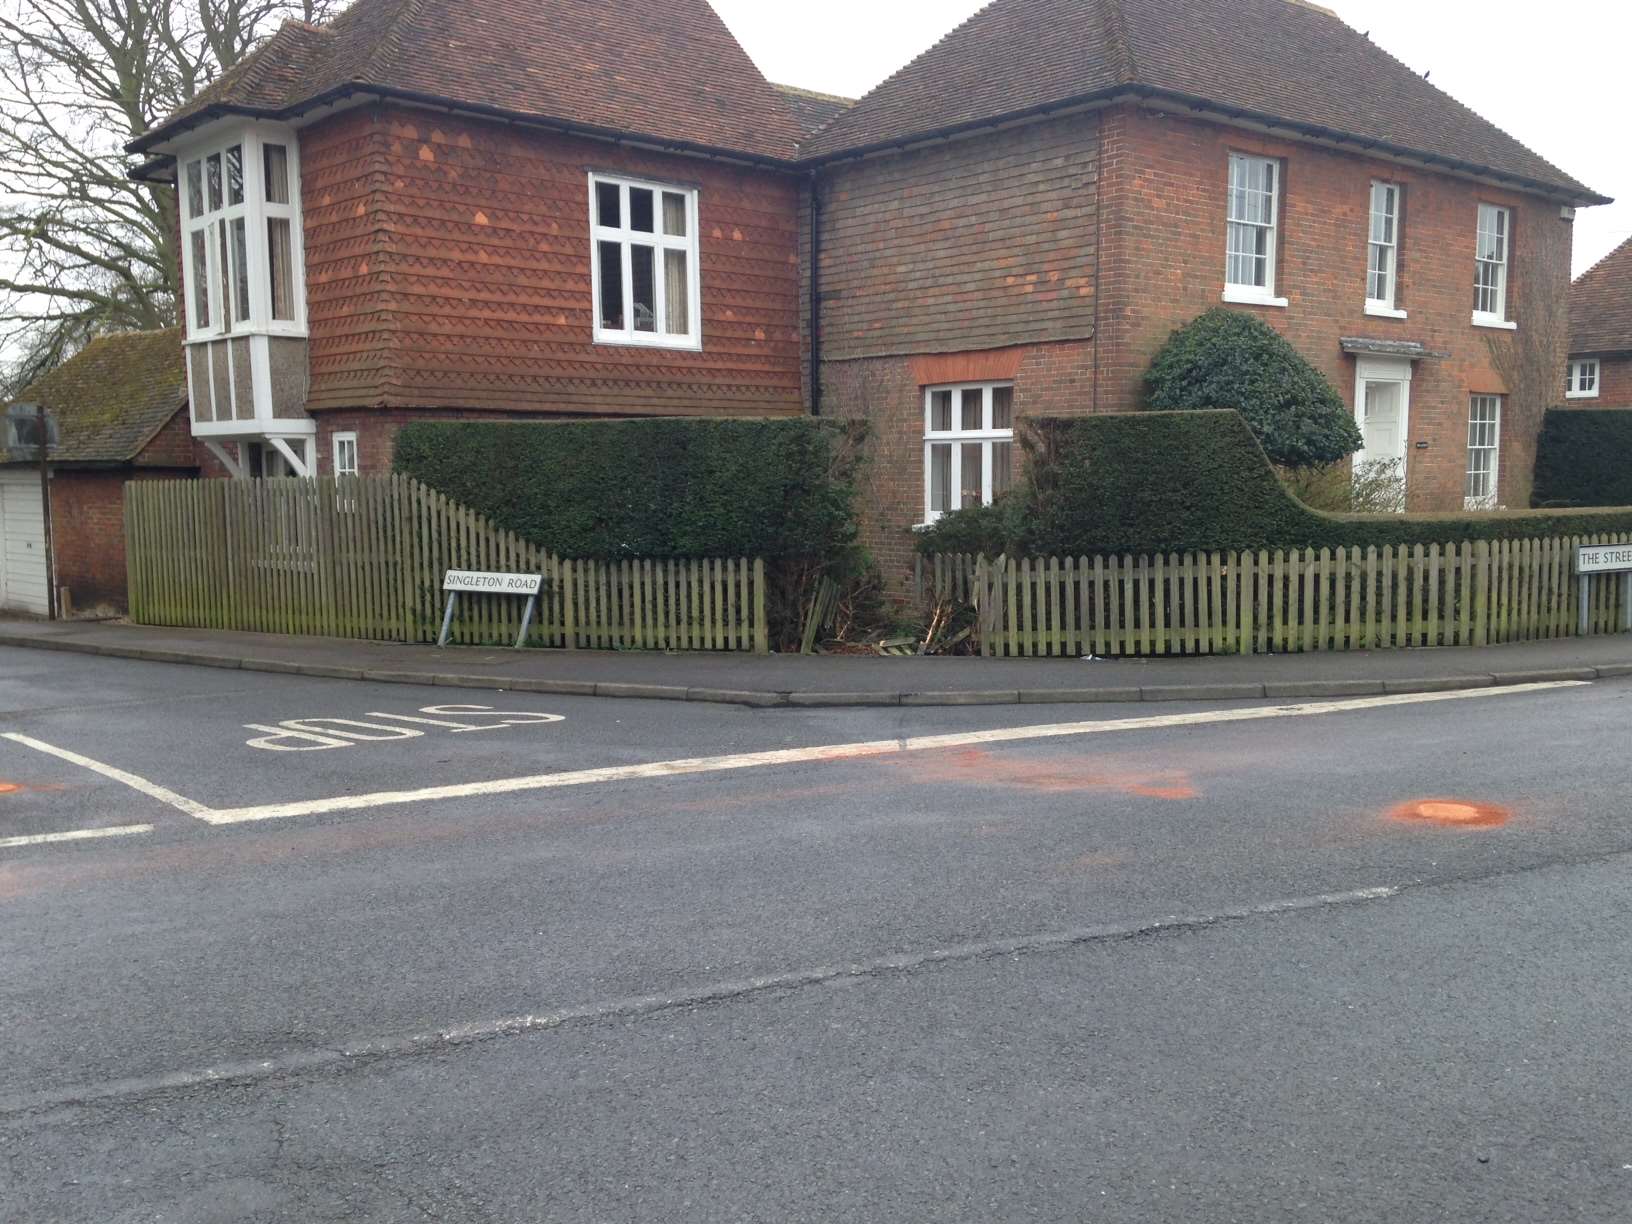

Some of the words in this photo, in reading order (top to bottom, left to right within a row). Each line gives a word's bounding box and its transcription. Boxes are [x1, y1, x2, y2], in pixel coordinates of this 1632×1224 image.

[1582, 552, 1599, 565] THE
[446, 574, 503, 587] SINGLETON
[507, 578, 537, 589] ROAD
[243, 704, 565, 751] STOP
